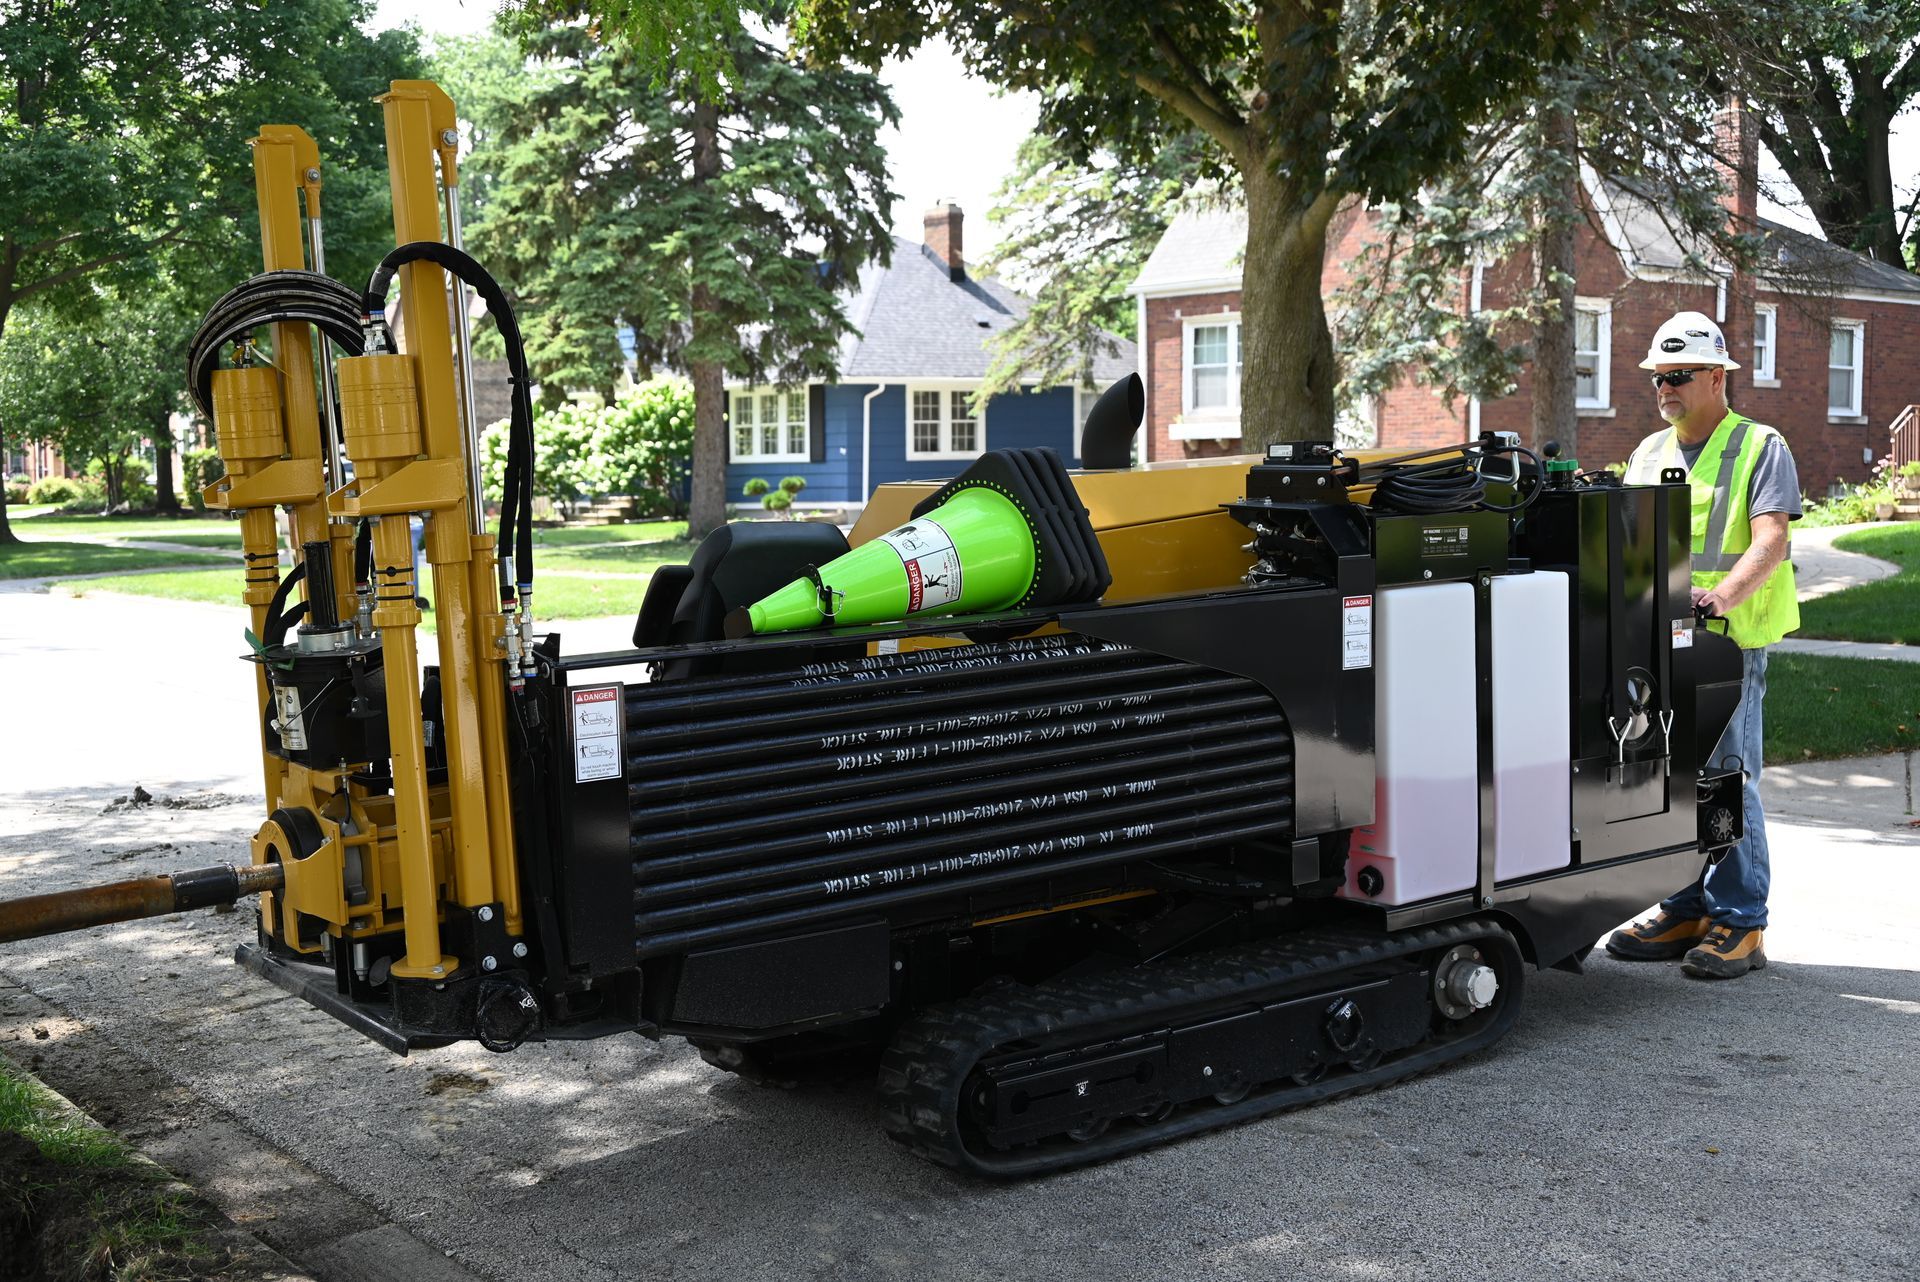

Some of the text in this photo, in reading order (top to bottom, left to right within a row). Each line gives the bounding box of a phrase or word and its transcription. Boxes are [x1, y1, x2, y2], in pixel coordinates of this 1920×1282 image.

[909, 563, 920, 603] DANGER
[801, 661, 849, 676] STICK
[856, 656, 895, 671] FIRE
[583, 691, 614, 702] DANGER
[1058, 703, 1084, 715] USA
[820, 732, 867, 749] STICK
[836, 713, 1165, 771] MADE IN USA P/N 216492-001-1 FIRE STICK
[876, 725, 913, 742] FIRE
[826, 779, 1157, 845] MADE IN USA P/N 216492-001-1 FIRE STICK
[824, 823, 1154, 895] MADE IN USA P/N 216492-001-1 FIRE STICK
